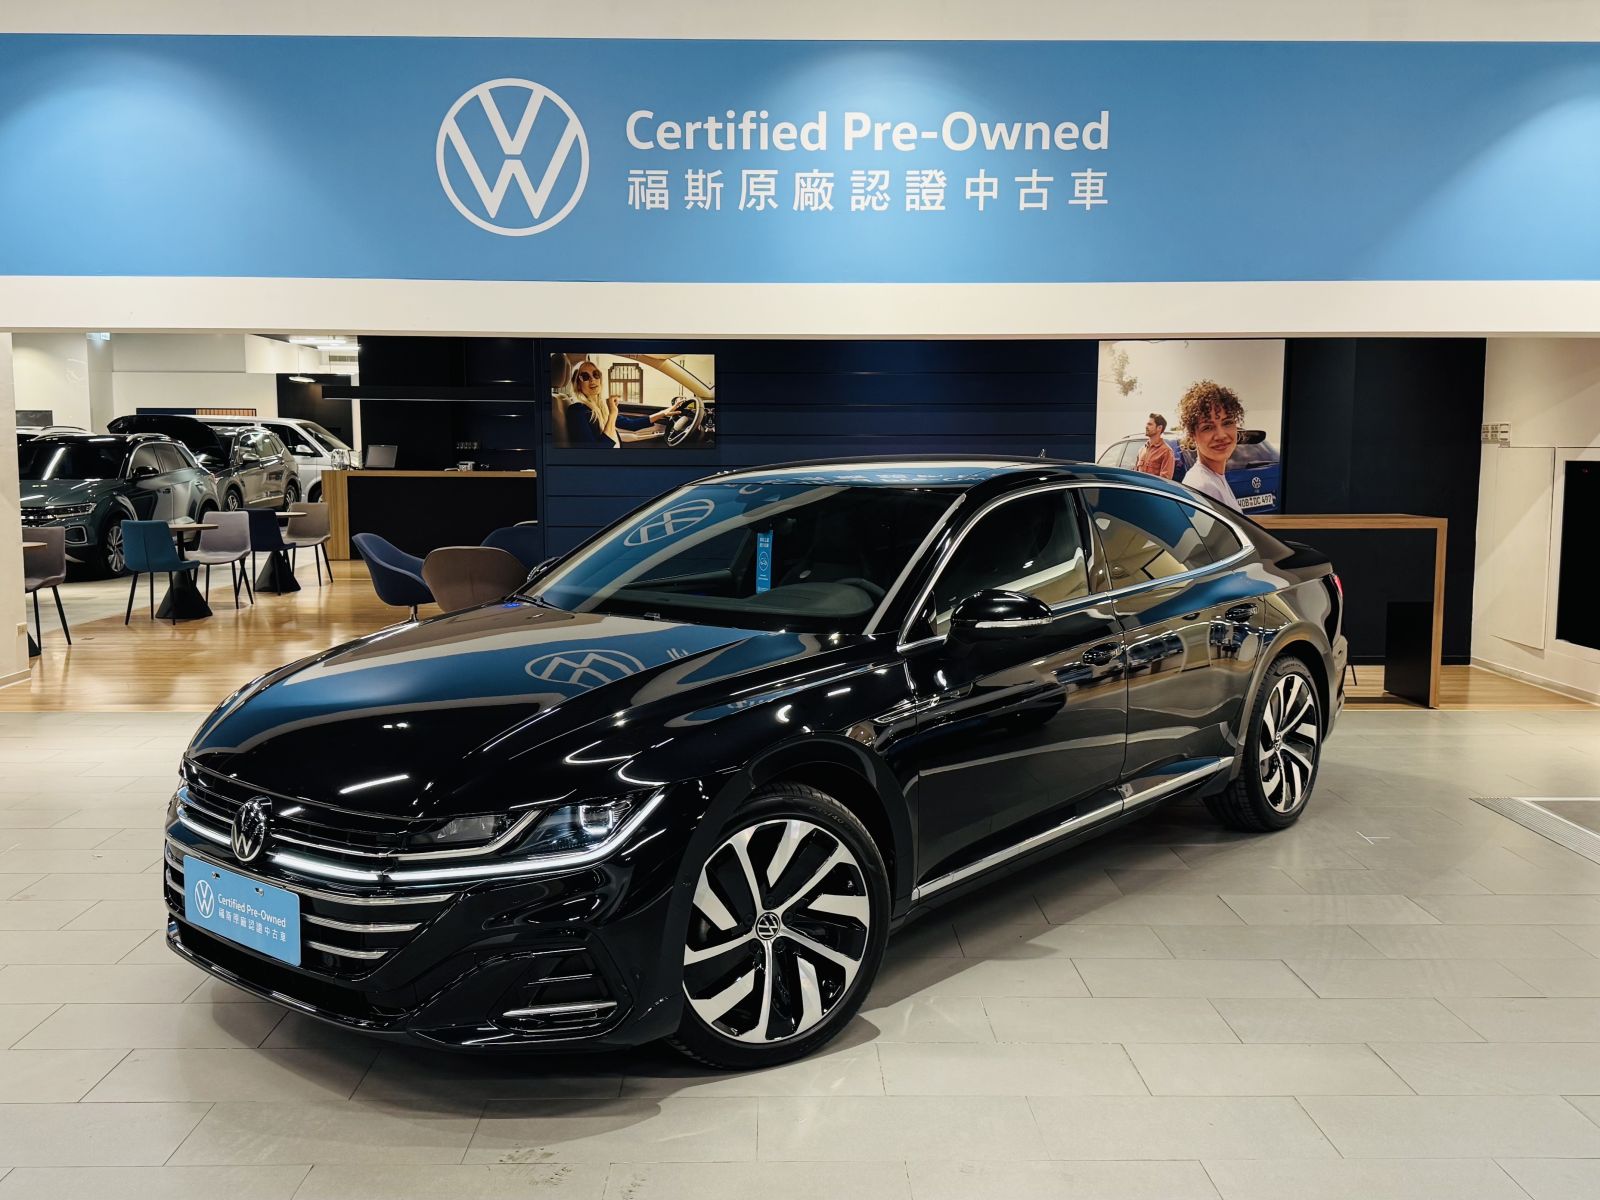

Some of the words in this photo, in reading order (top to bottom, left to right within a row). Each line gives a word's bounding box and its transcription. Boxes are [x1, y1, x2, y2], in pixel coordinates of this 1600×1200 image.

[626, 109, 827, 151] Certified
[844, 110, 1109, 151] Pre-Owned
[627, 168, 1109, 212] 福斯原廠認證中古車
[217, 893, 246, 913] Certified
[246, 904, 287, 928] Pre-Owned
